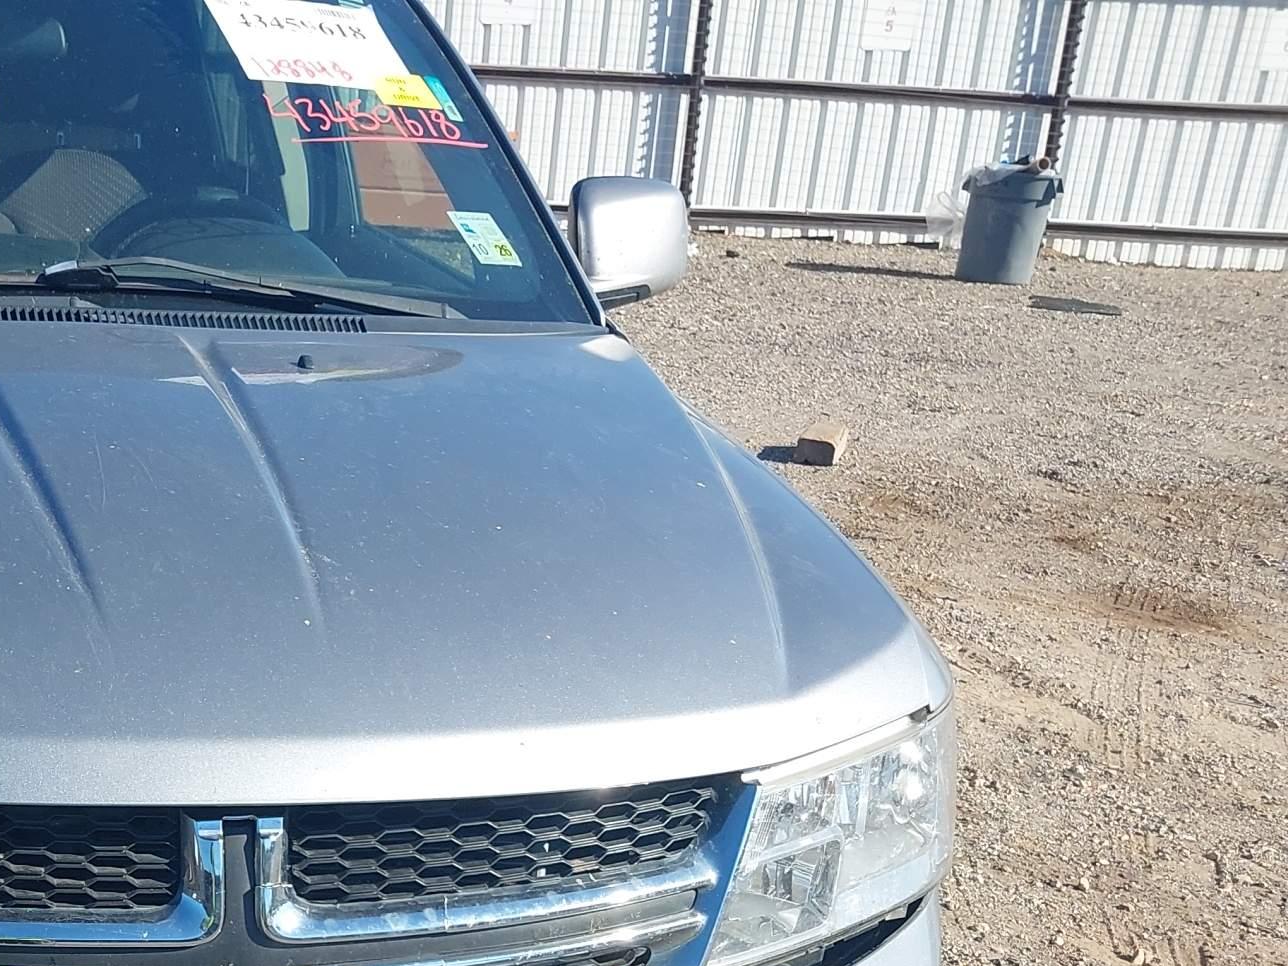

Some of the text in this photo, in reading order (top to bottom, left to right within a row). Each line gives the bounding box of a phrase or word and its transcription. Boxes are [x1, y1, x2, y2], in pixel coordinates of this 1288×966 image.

[263, 93, 461, 140] 43459618
[472, 243, 513, 257] 10 26
